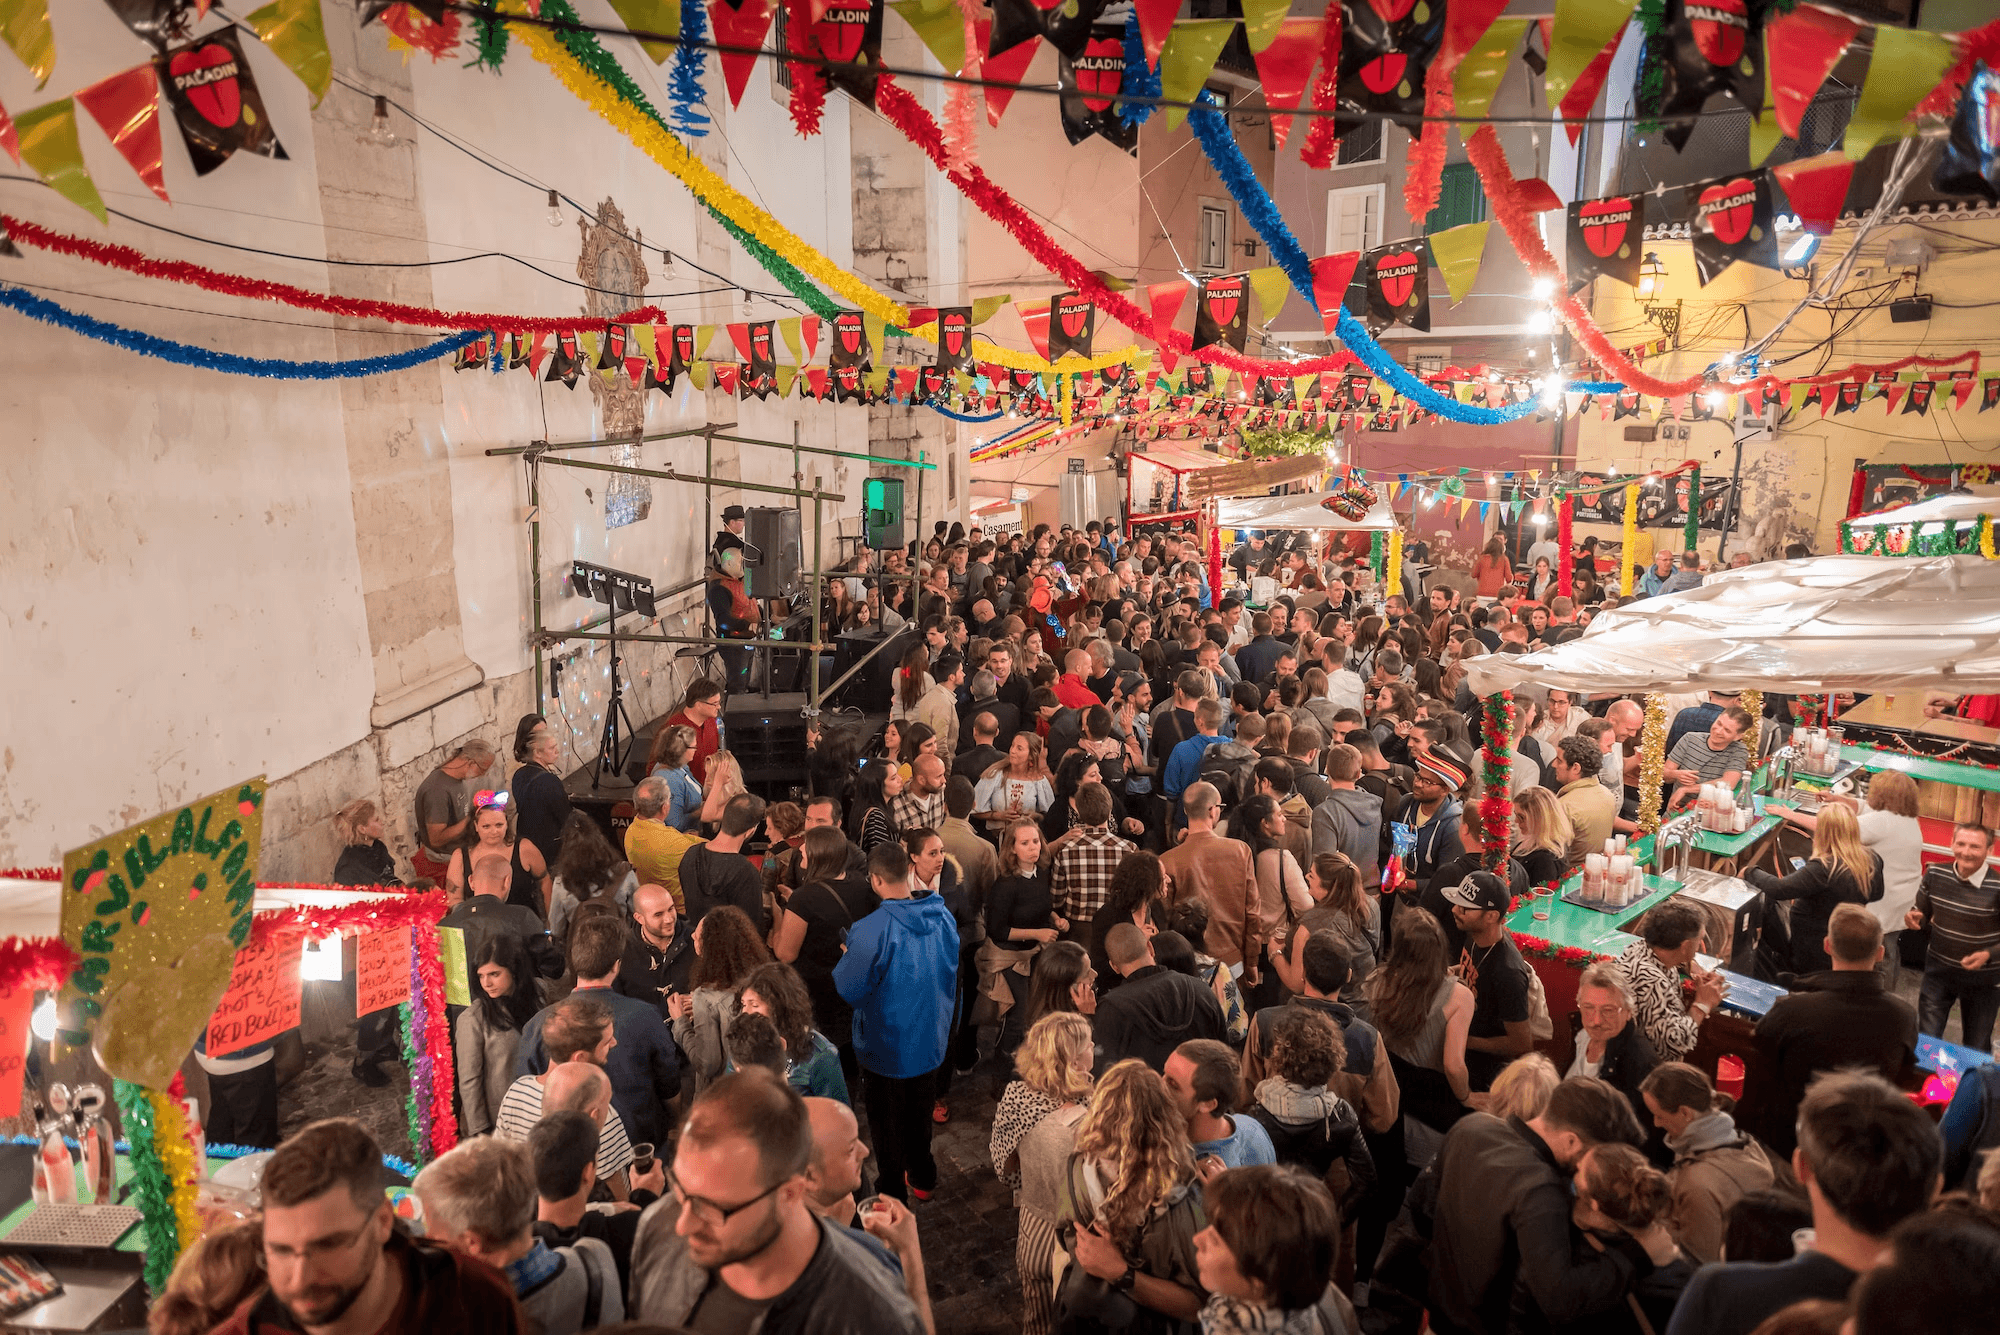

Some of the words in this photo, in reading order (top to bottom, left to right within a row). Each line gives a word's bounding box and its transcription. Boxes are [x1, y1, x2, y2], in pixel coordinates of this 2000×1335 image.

[821, 10, 869, 23] ALADIN
[1685, 6, 1748, 29] PALADIN
[174, 62, 238, 88] PALADIN
[1700, 191, 1756, 215] PALADIN
[1580, 212, 1631, 228] PALADIN
[1377, 264, 1418, 279] PALADIN
[1206, 289, 1241, 299] PALADIN
[1059, 304, 1090, 314] PALADIN
[210, 1022, 241, 1052] RED
[245, 1008, 278, 1037] BULL
